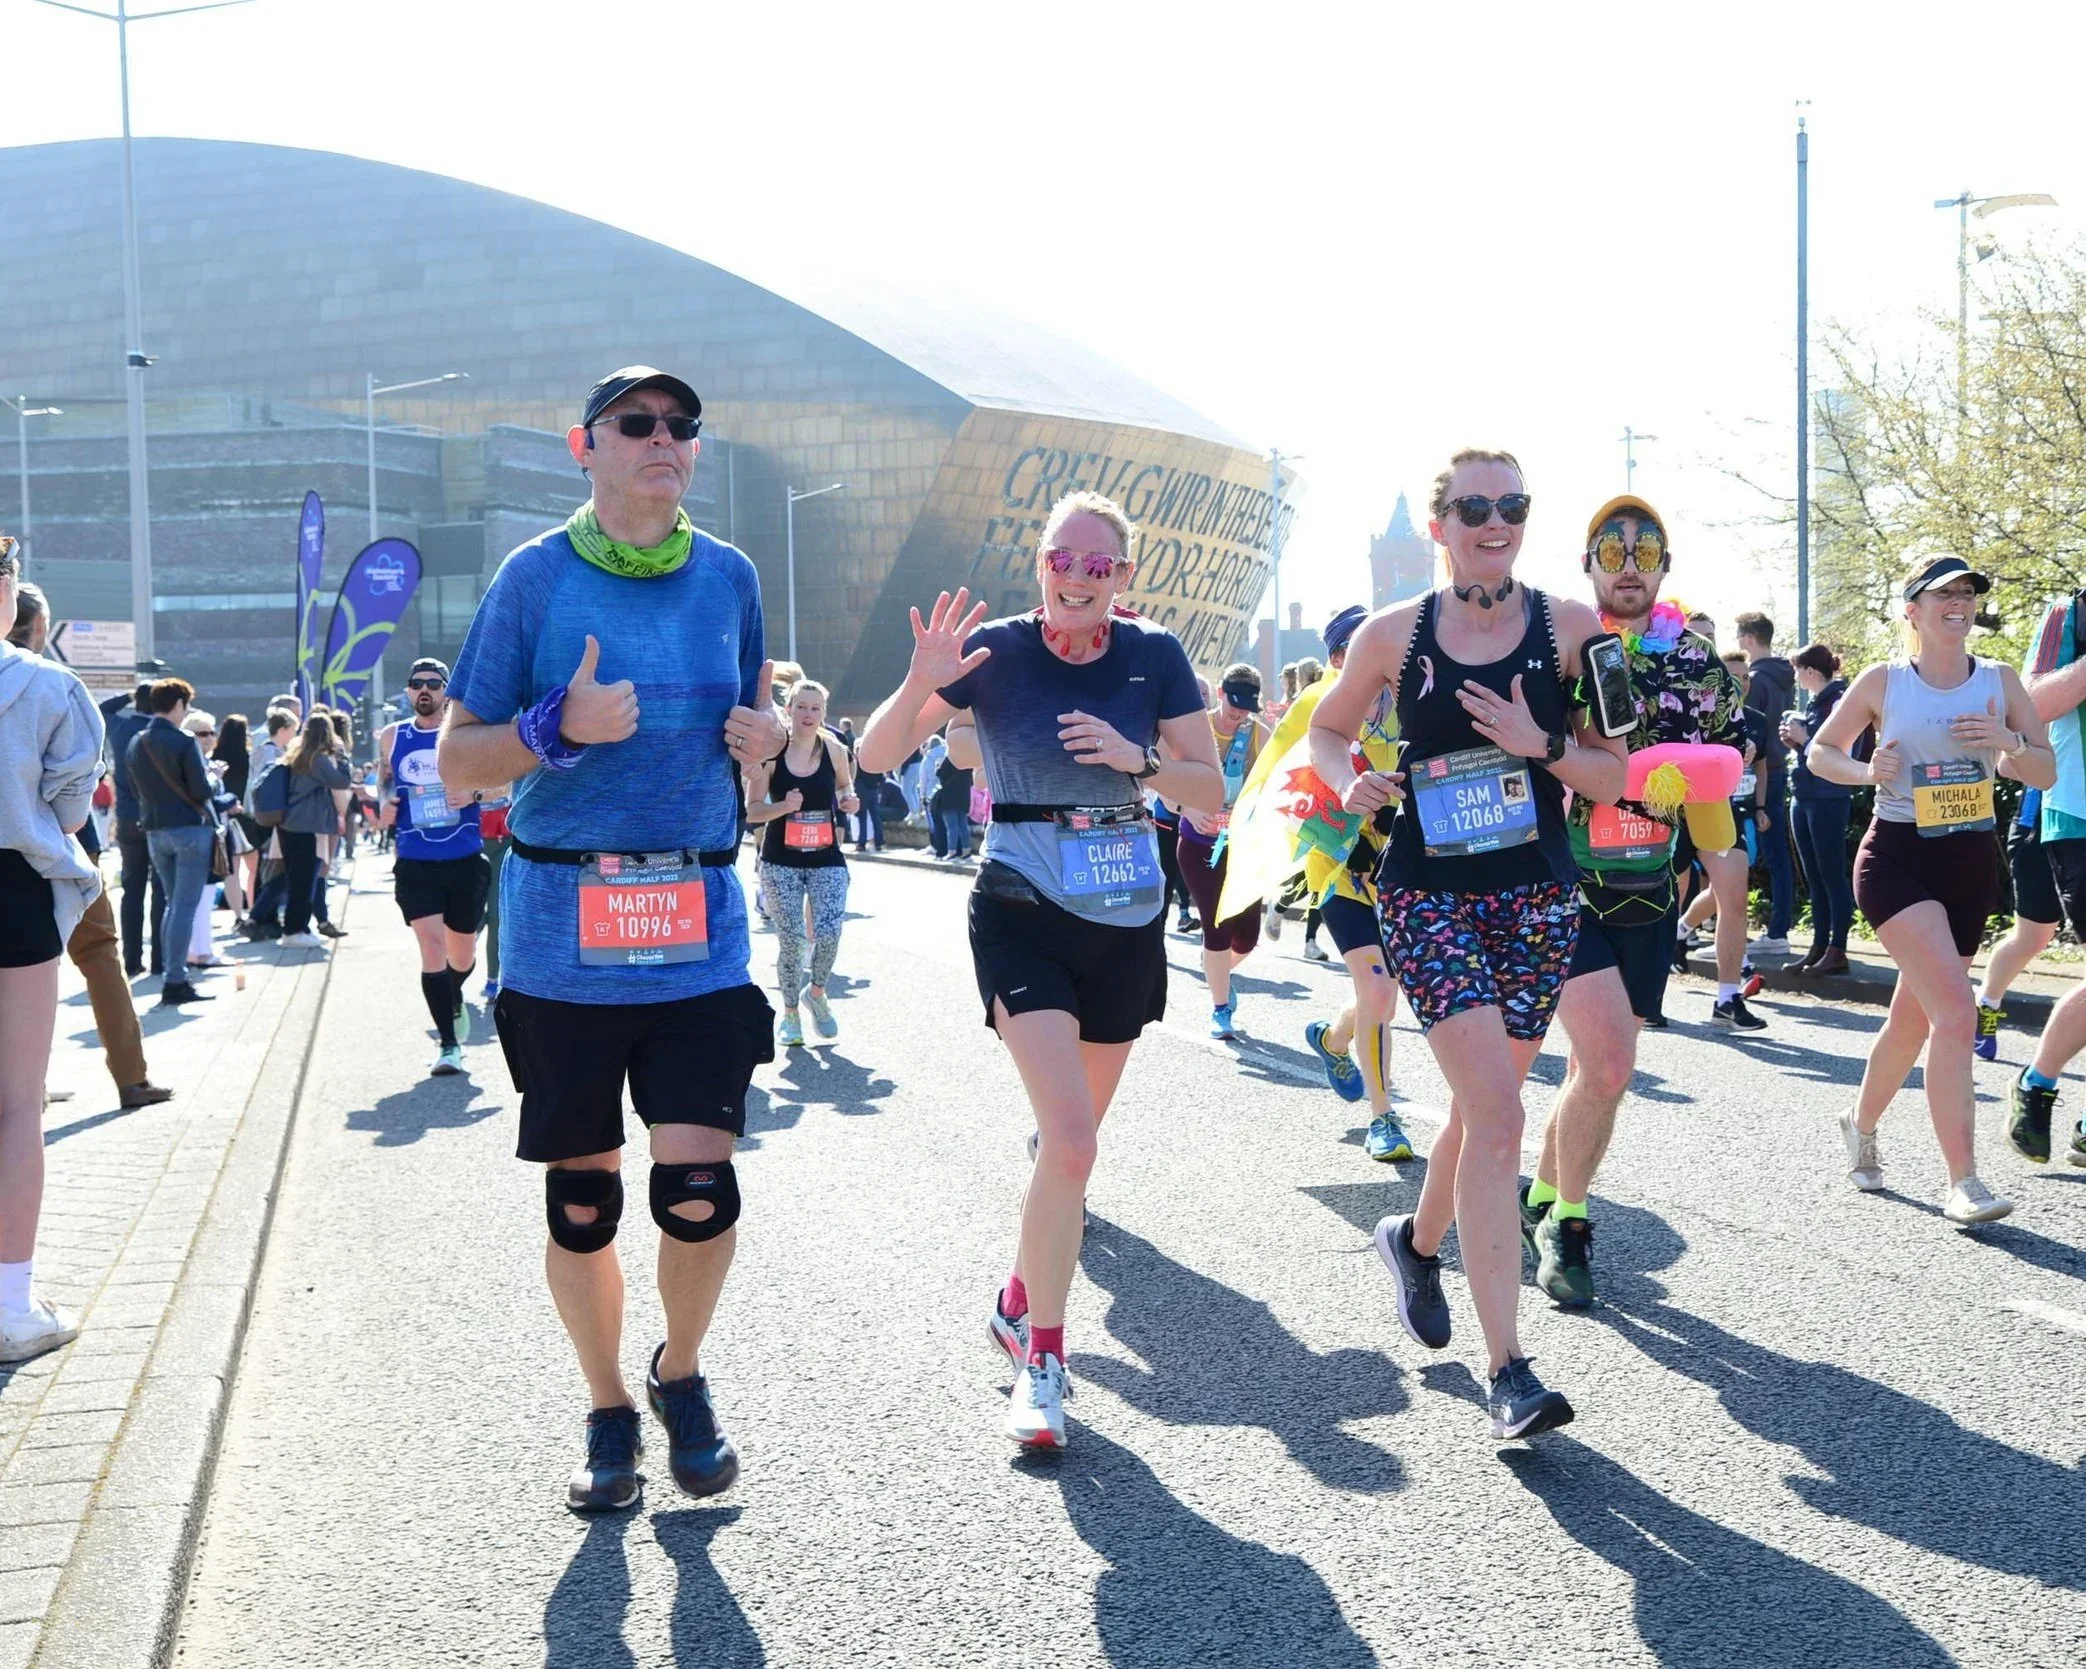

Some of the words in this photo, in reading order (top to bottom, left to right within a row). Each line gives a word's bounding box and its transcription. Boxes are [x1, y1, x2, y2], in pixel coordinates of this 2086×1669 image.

[1455, 784, 1491, 808] SAM
[1932, 787, 1980, 804] MICHALA
[1451, 804, 1504, 832] 12068
[1940, 803, 1977, 819] 23068
[1620, 821, 1653, 840] 7059
[1087, 842, 1133, 863] CLAIRE
[604, 876, 639, 885] CARDIFF
[639, 875, 660, 884] HALF
[1092, 862, 1137, 885] 12662
[607, 891, 678, 914] MARTYN
[616, 914, 672, 939] 10996
